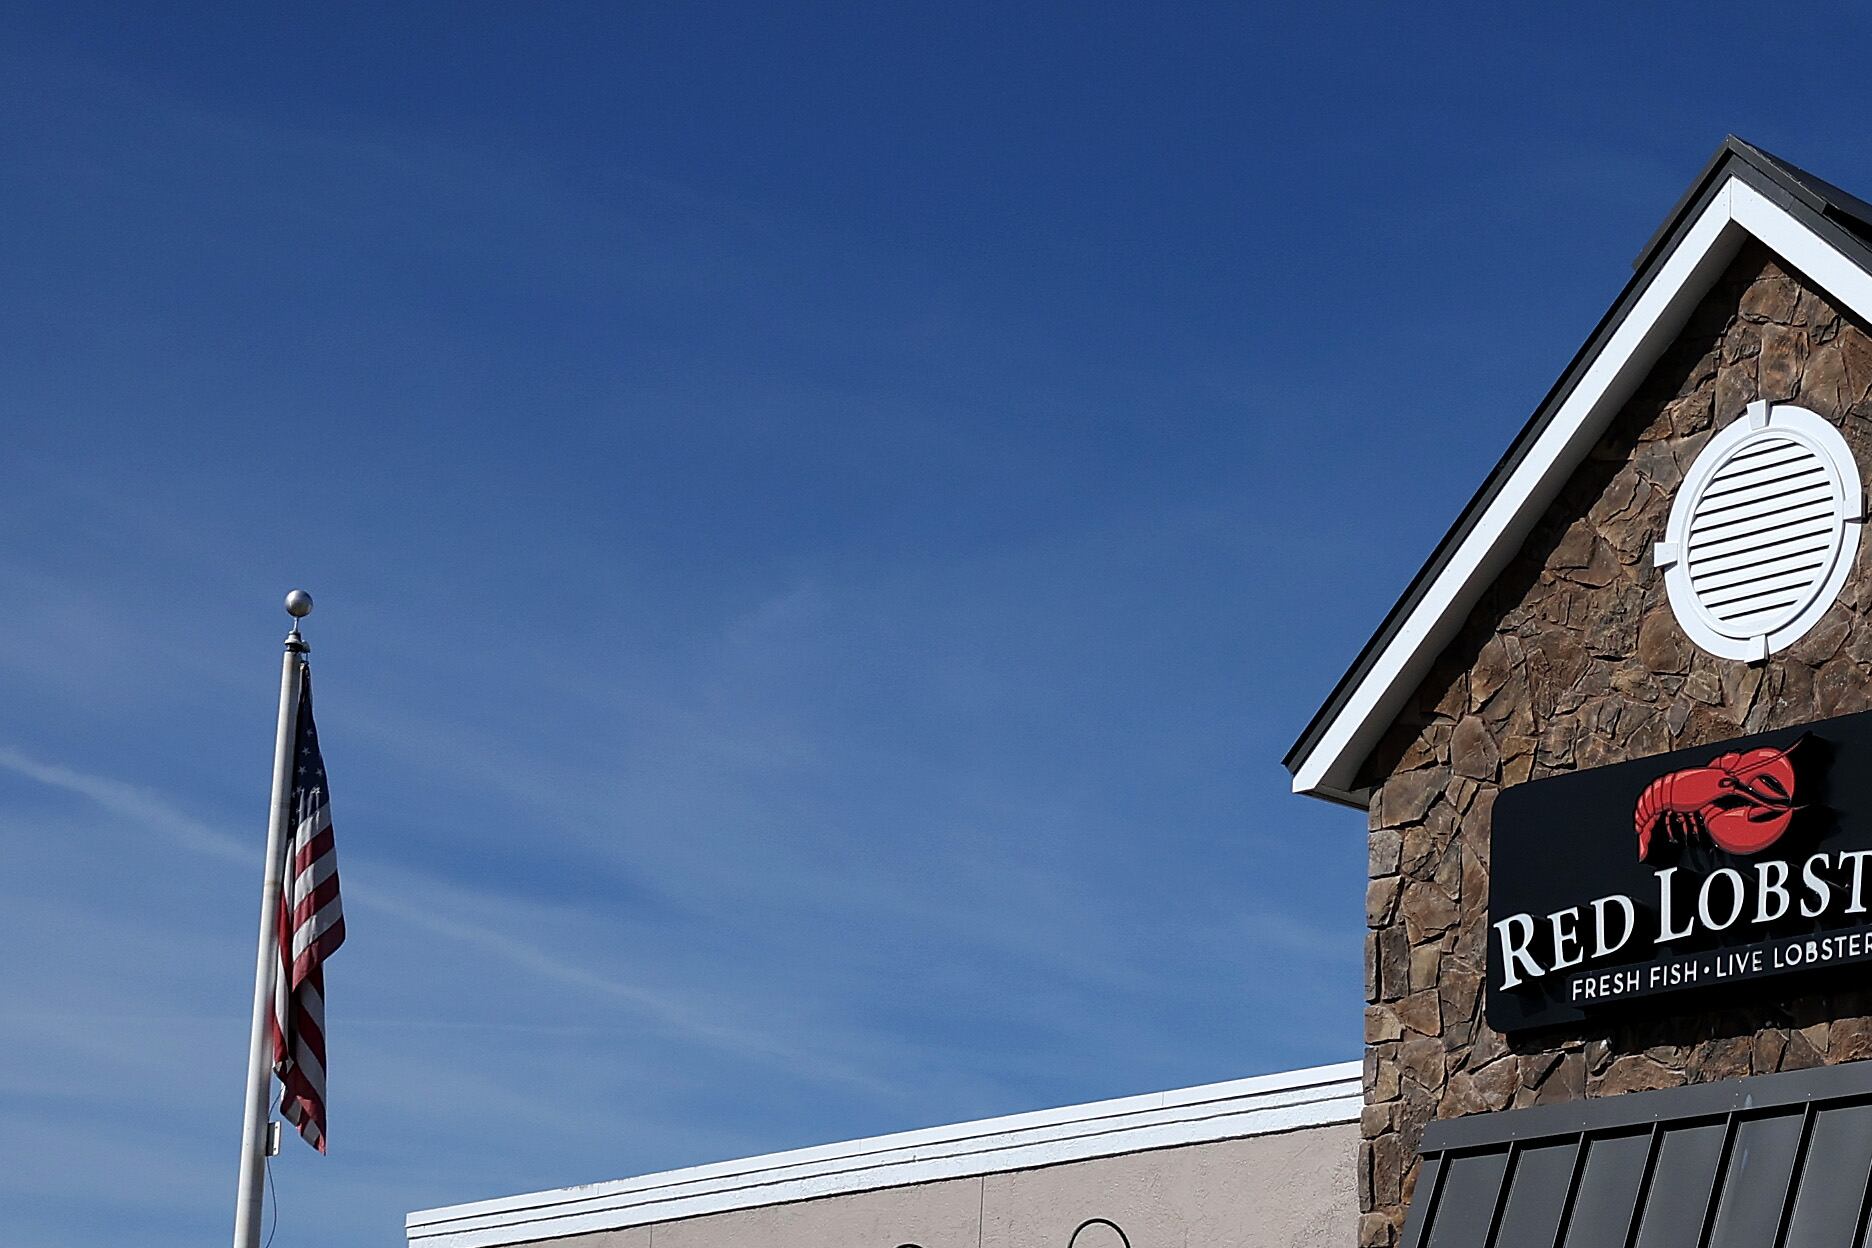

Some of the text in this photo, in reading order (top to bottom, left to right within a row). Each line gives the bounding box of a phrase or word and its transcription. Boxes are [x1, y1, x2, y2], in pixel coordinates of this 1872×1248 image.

[1493, 894, 1635, 992] RED
[1571, 971, 1641, 1001] FRESH
[1649, 959, 1698, 989] FISH
[1716, 949, 1763, 978] LIVE
